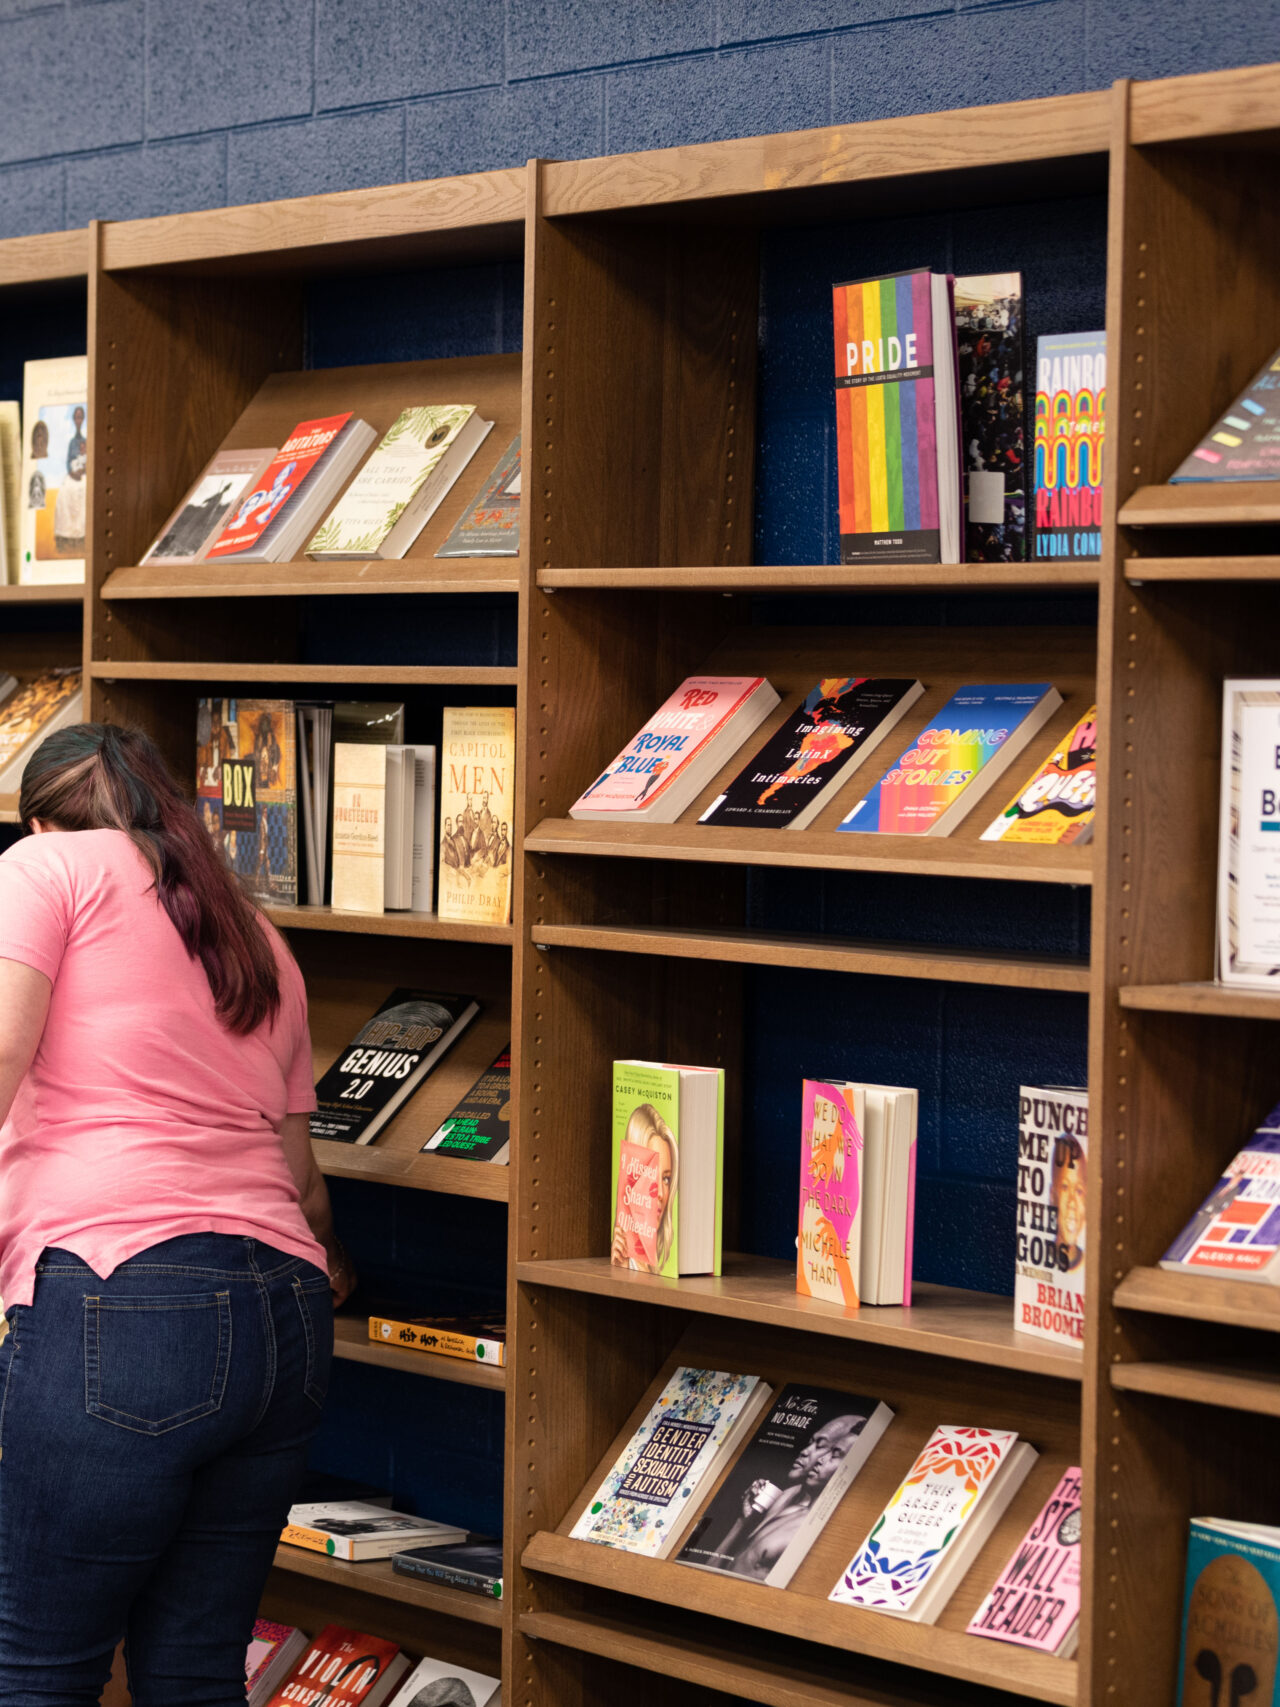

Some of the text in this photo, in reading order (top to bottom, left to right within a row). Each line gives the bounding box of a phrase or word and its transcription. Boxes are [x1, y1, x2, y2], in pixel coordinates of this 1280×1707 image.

[846, 333, 918, 376] PRIDE
[1038, 353, 1106, 397] RAINBO
[1036, 486, 1103, 528] RAINBO
[1036, 533, 1069, 557] LYDIA
[644, 711, 705, 730] WHITE
[795, 723, 865, 737] Imagining
[633, 733, 690, 753] ROYAL
[917, 728, 1009, 746] COMING
[449, 742, 506, 758] CAPITOL
[785, 748, 832, 760] LatinX
[899, 748, 949, 765] OUT
[615, 756, 664, 774] BLUE
[223, 763, 254, 807] BOX
[448, 763, 506, 796] MEN
[751, 772, 822, 785] Intimacies
[881, 769, 973, 786] STORIES
[1020, 770, 1096, 812] QUEE
[446, 891, 503, 908] PHILIP DRAY
[360, 1021, 443, 1050] HIP-HOP
[340, 1048, 419, 1079] GENIUS
[340, 1079, 374, 1099] 2.0
[615, 1085, 672, 1101] CASEY McQUISTON
[457, 1119, 480, 1127] AHEAD
[465, 1112, 491, 1120] CALLED
[813, 1101, 847, 1125] WE DO
[1020, 1095, 1088, 1137] PUNCH
[469, 1134, 493, 1144] TRIBE
[804, 1128, 853, 1157] WHAT WE
[1019, 1130, 1082, 1169] ME UP
[626, 1157, 658, 1181] Kissed
[812, 1160, 843, 1184] DO IN
[1018, 1164, 1045, 1197] TO
[623, 1185, 653, 1209] Shara
[802, 1186, 851, 1217] THE DARK
[618, 1211, 657, 1239] Wheeler
[1018, 1199, 1059, 1235] THE
[801, 1230, 851, 1261] MICHELLE
[1016, 1232, 1069, 1273] GODS
[811, 1261, 838, 1287] HART
[1037, 1283, 1085, 1315] BRIAN
[1022, 1303, 1084, 1339] BROOME
[399, 1327, 439, 1348] HIP HOP
[771, 1412, 812, 1429] NO SHADE
[652, 1426, 707, 1449] GENDER
[623, 1473, 637, 1488] AND
[633, 1457, 689, 1481] SEXUALITY
[631, 1476, 679, 1497] AUTISM
[923, 1483, 955, 1497] THIS
[901, 1497, 957, 1513] ARAB IS
[897, 1512, 943, 1527] QUEER
[1003, 1541, 1072, 1593] WALL
[974, 1587, 1066, 1641] READER
[339, 1642, 354, 1653] The
[298, 1649, 377, 1694] VIOLIN
